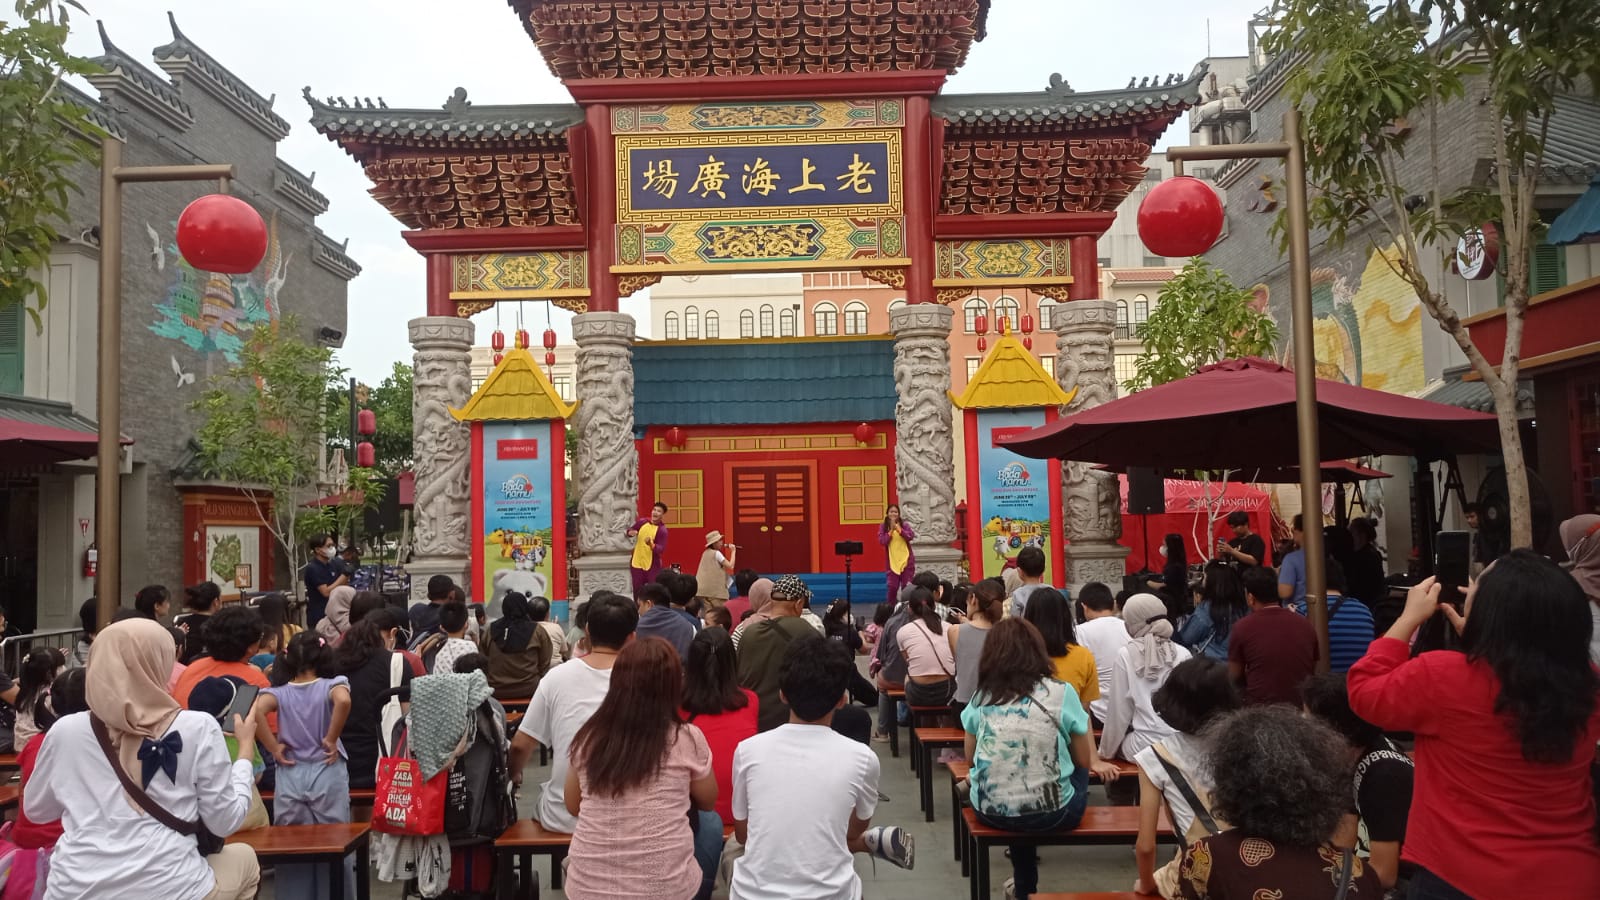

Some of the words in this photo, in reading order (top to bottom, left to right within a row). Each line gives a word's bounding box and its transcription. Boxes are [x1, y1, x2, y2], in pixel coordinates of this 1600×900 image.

[641, 152, 877, 200] 老上海廣場
[385, 807, 406, 821] ADA
